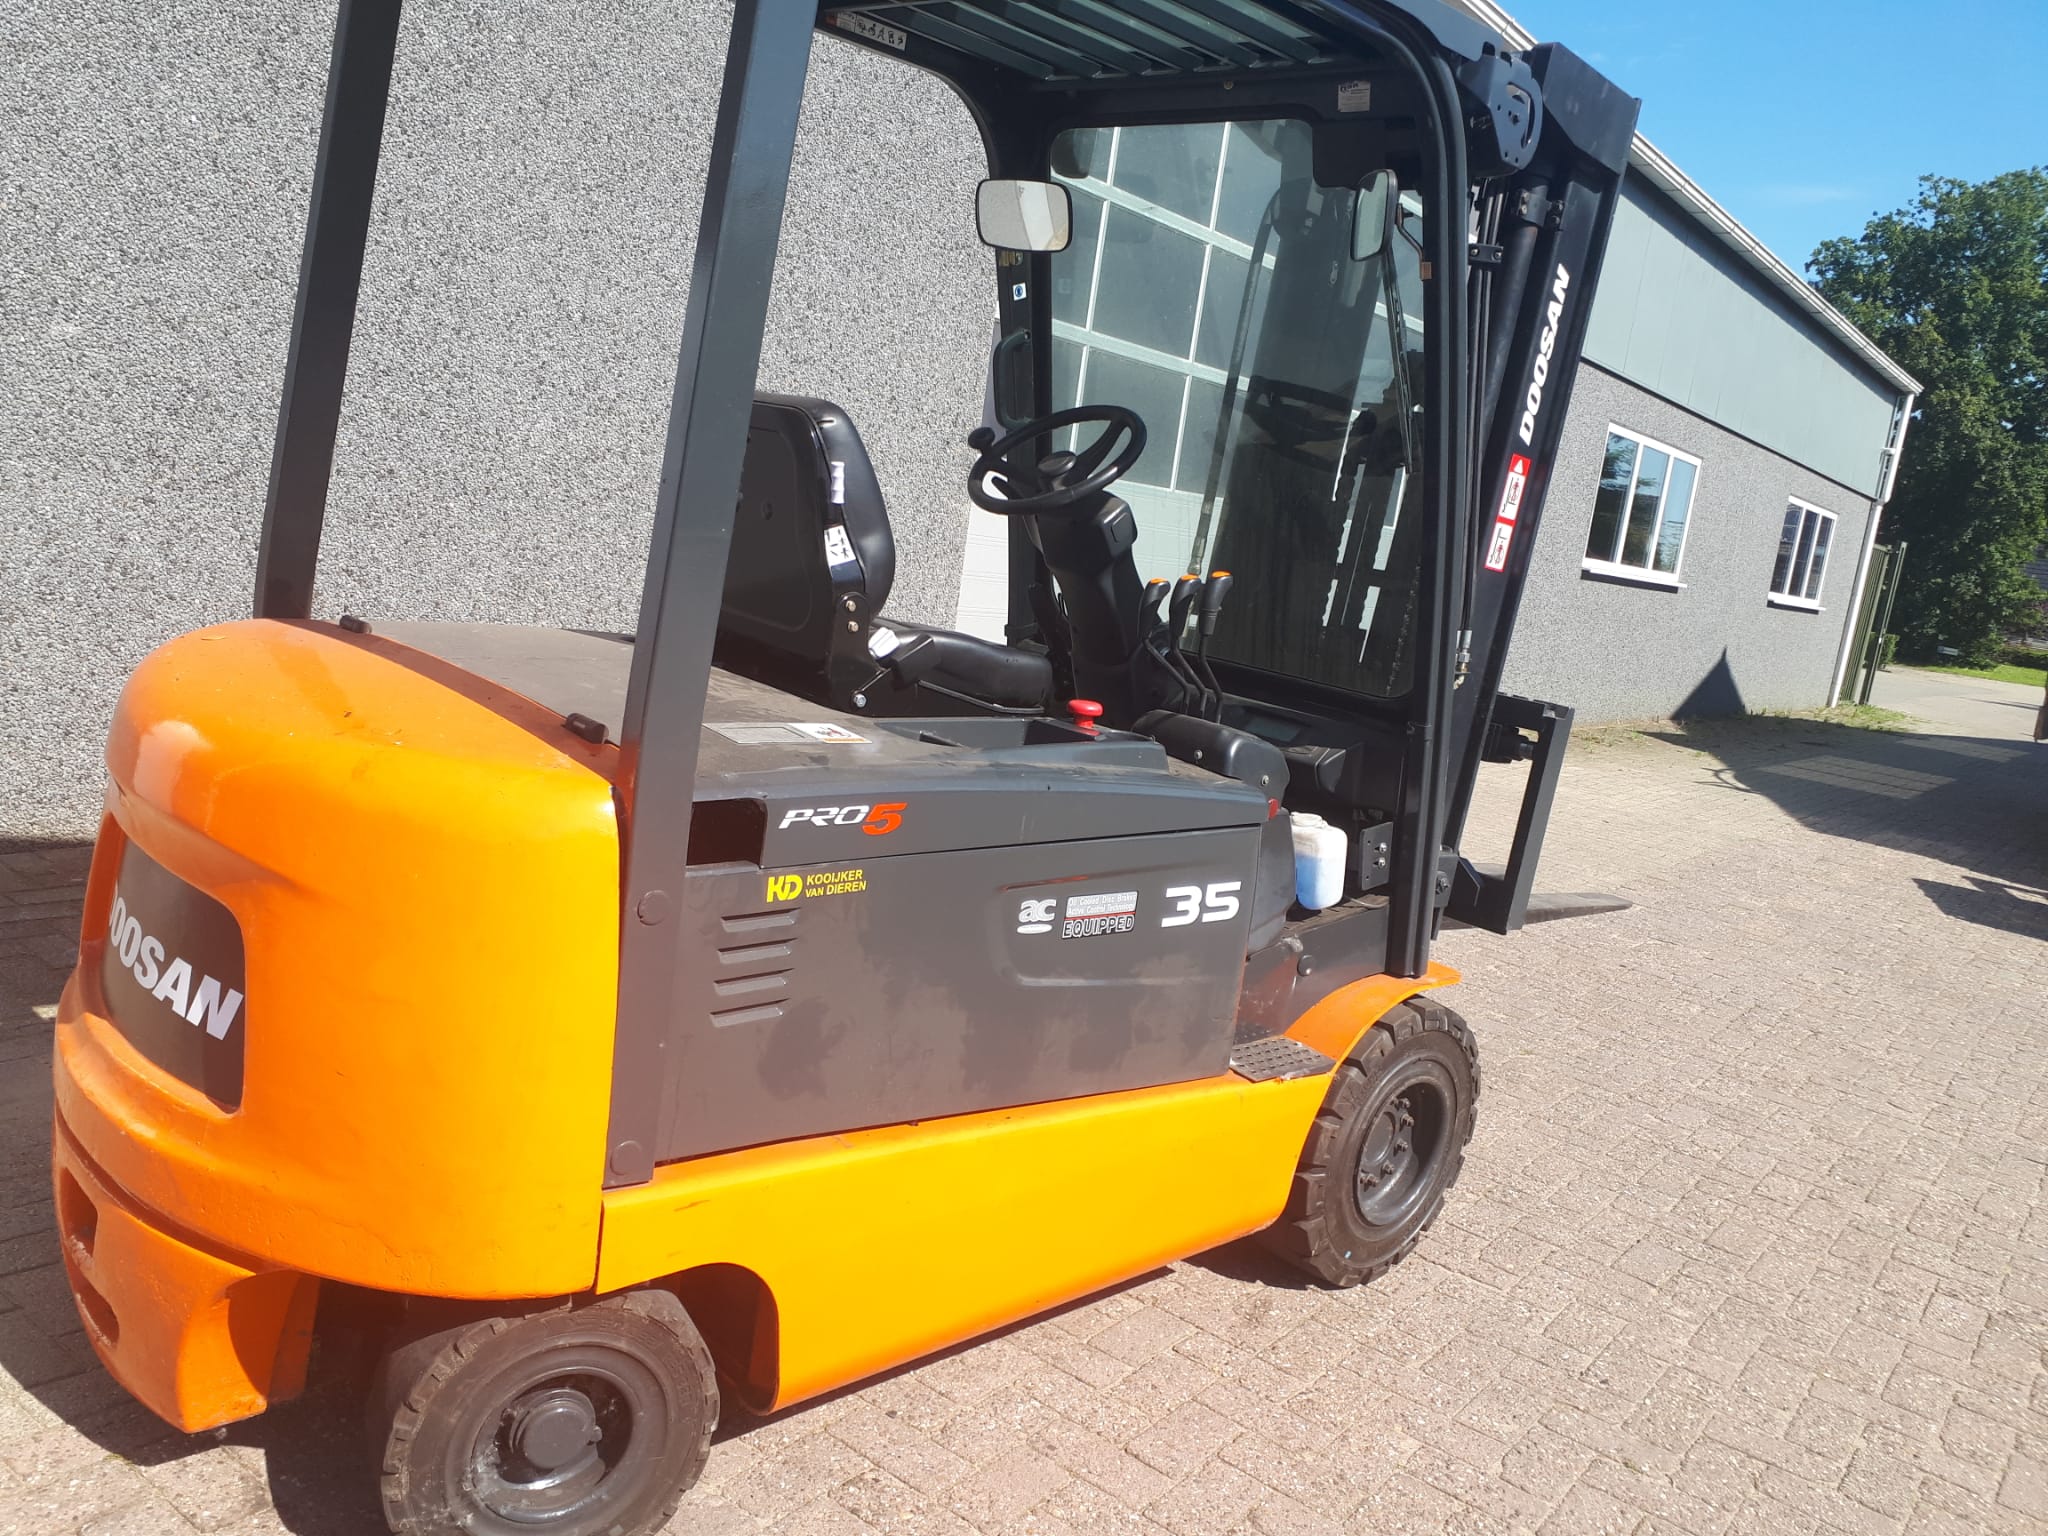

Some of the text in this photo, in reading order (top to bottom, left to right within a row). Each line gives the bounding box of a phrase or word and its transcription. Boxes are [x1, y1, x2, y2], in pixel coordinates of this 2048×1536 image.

[1519, 263, 1570, 447] DOOSAN
[766, 874, 803, 903] KD
[805, 880, 866, 898] VAN DIEREN
[806, 869, 863, 886] KOOIJKER
[1161, 881, 1242, 928] 35
[1062, 914, 1135, 939] EQUIPPED
[109, 880, 244, 1041] OOSAN
